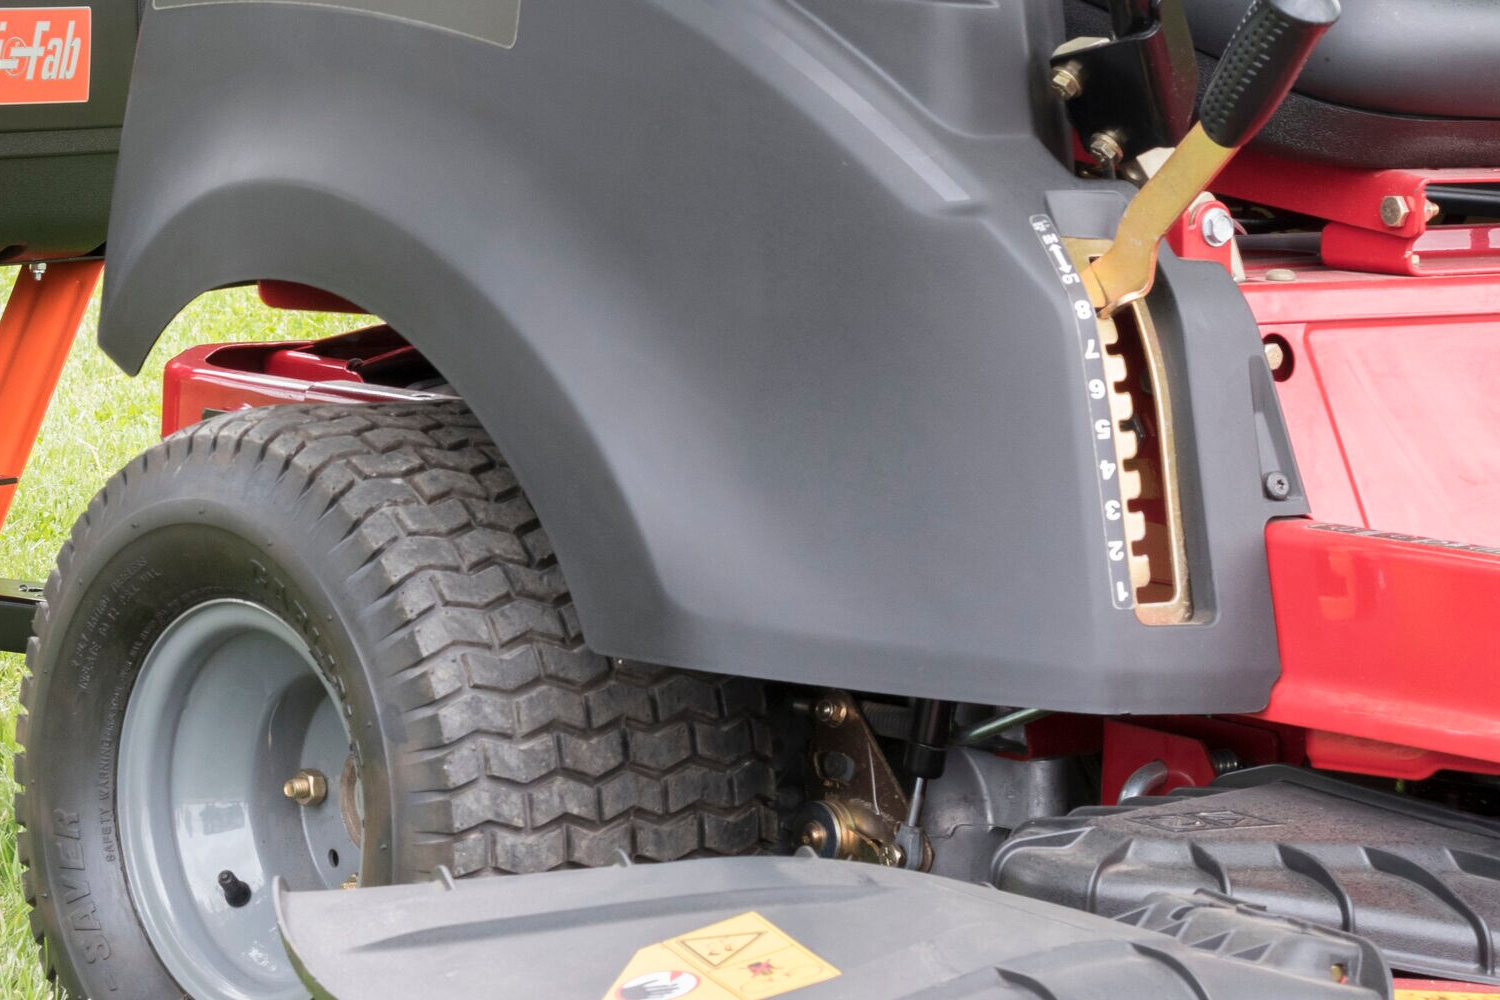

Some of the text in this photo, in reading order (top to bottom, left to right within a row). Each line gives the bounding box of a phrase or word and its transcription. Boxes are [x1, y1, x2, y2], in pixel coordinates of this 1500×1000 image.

[1075, 300, 1092, 319] 8
[1085, 339, 1100, 360] 7
[1088, 379, 1106, 399] 6
[1094, 419, 1111, 440] 5
[1100, 460, 1116, 480] 4
[1105, 500, 1121, 520] 3
[1108, 541, 1124, 561] 2
[1116, 581, 1129, 602] 1
[99, 807, 116, 863] SAFETY
